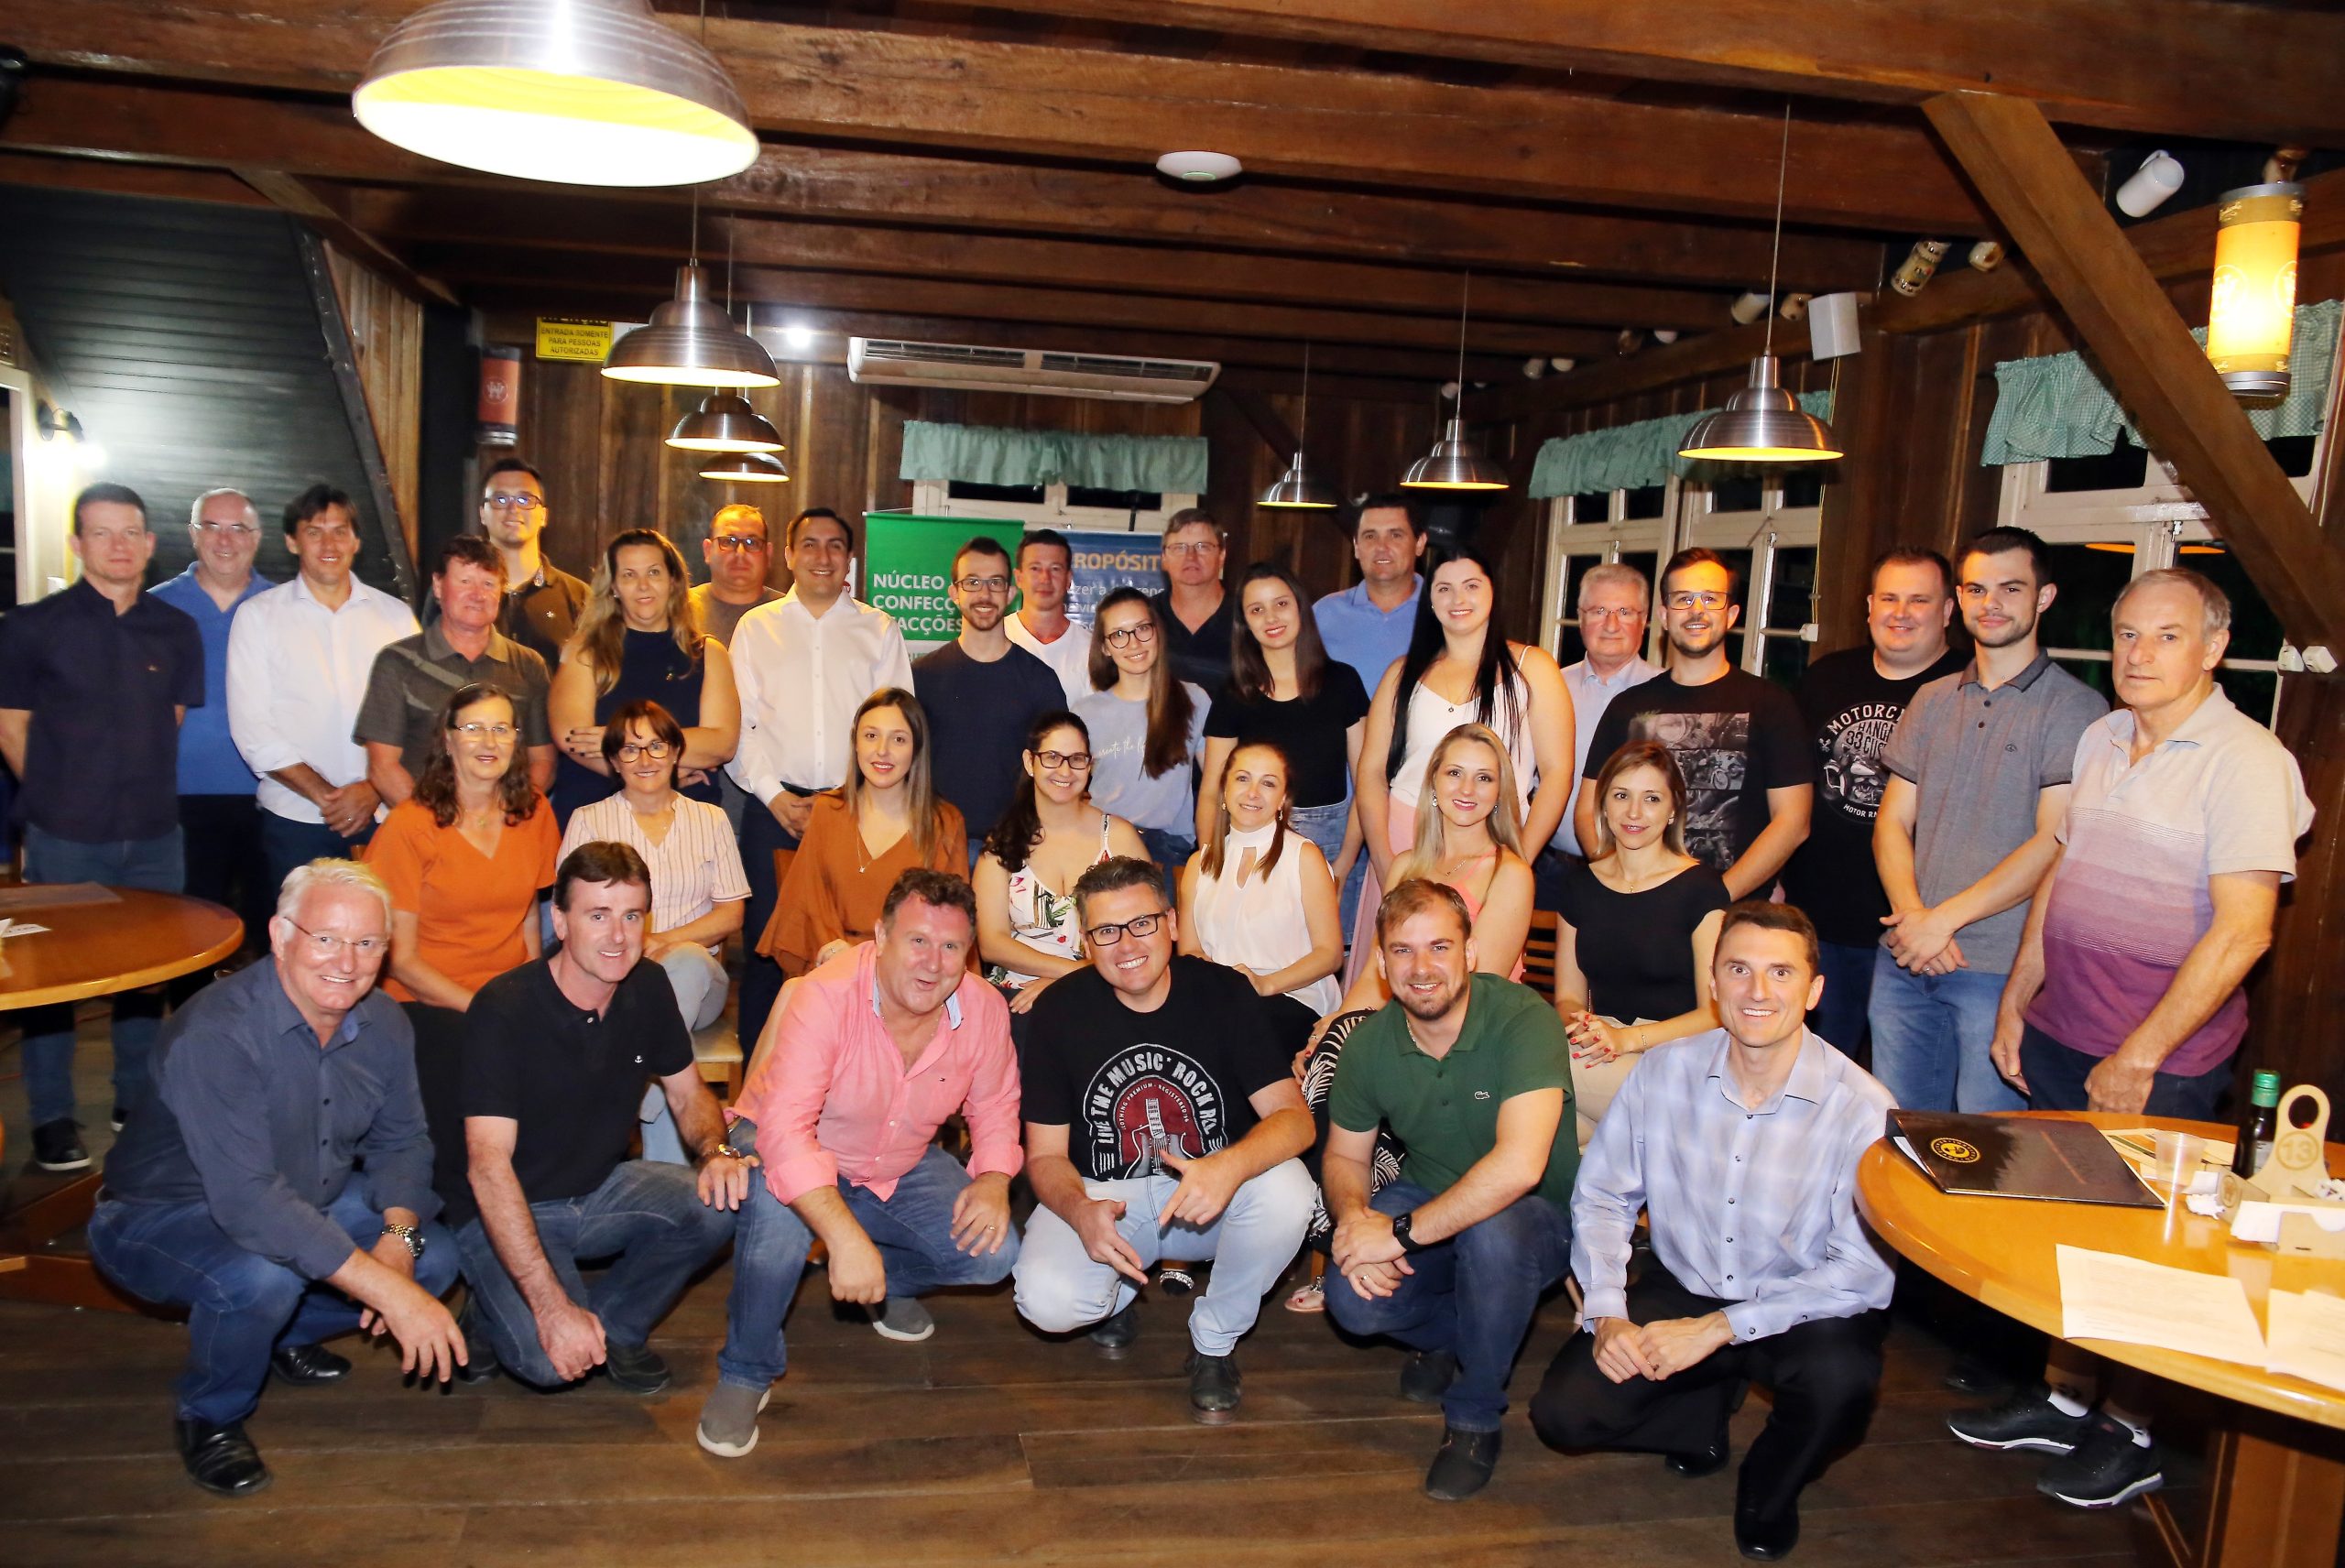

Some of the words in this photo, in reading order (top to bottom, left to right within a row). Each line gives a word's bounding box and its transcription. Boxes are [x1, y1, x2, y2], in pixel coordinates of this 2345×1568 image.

[541, 328, 573, 336] ENTRADA
[575, 330, 609, 338] SOMENTE
[569, 338, 601, 347] PESSOAS
[551, 347, 599, 355] AUTORIZADAS
[1073, 550, 1161, 572] ROPÓSIT
[873, 570, 944, 590] NÚCLEO
[872, 594, 955, 615] CONFECÇ
[891, 615, 963, 636] ACÇÕES
[1827, 704, 1904, 735] MOTORC
[1843, 803, 1866, 817] MOTOR
[1090, 1083, 1115, 1116] THE
[1107, 1051, 1163, 1088] MUSIC
[1172, 1061, 1215, 1107] ROCK
[1126, 1082, 1153, 1101] PREMIUM
[1158, 1083, 1187, 1114] REGISTERED
[2281, 1140, 2312, 1161] 13
